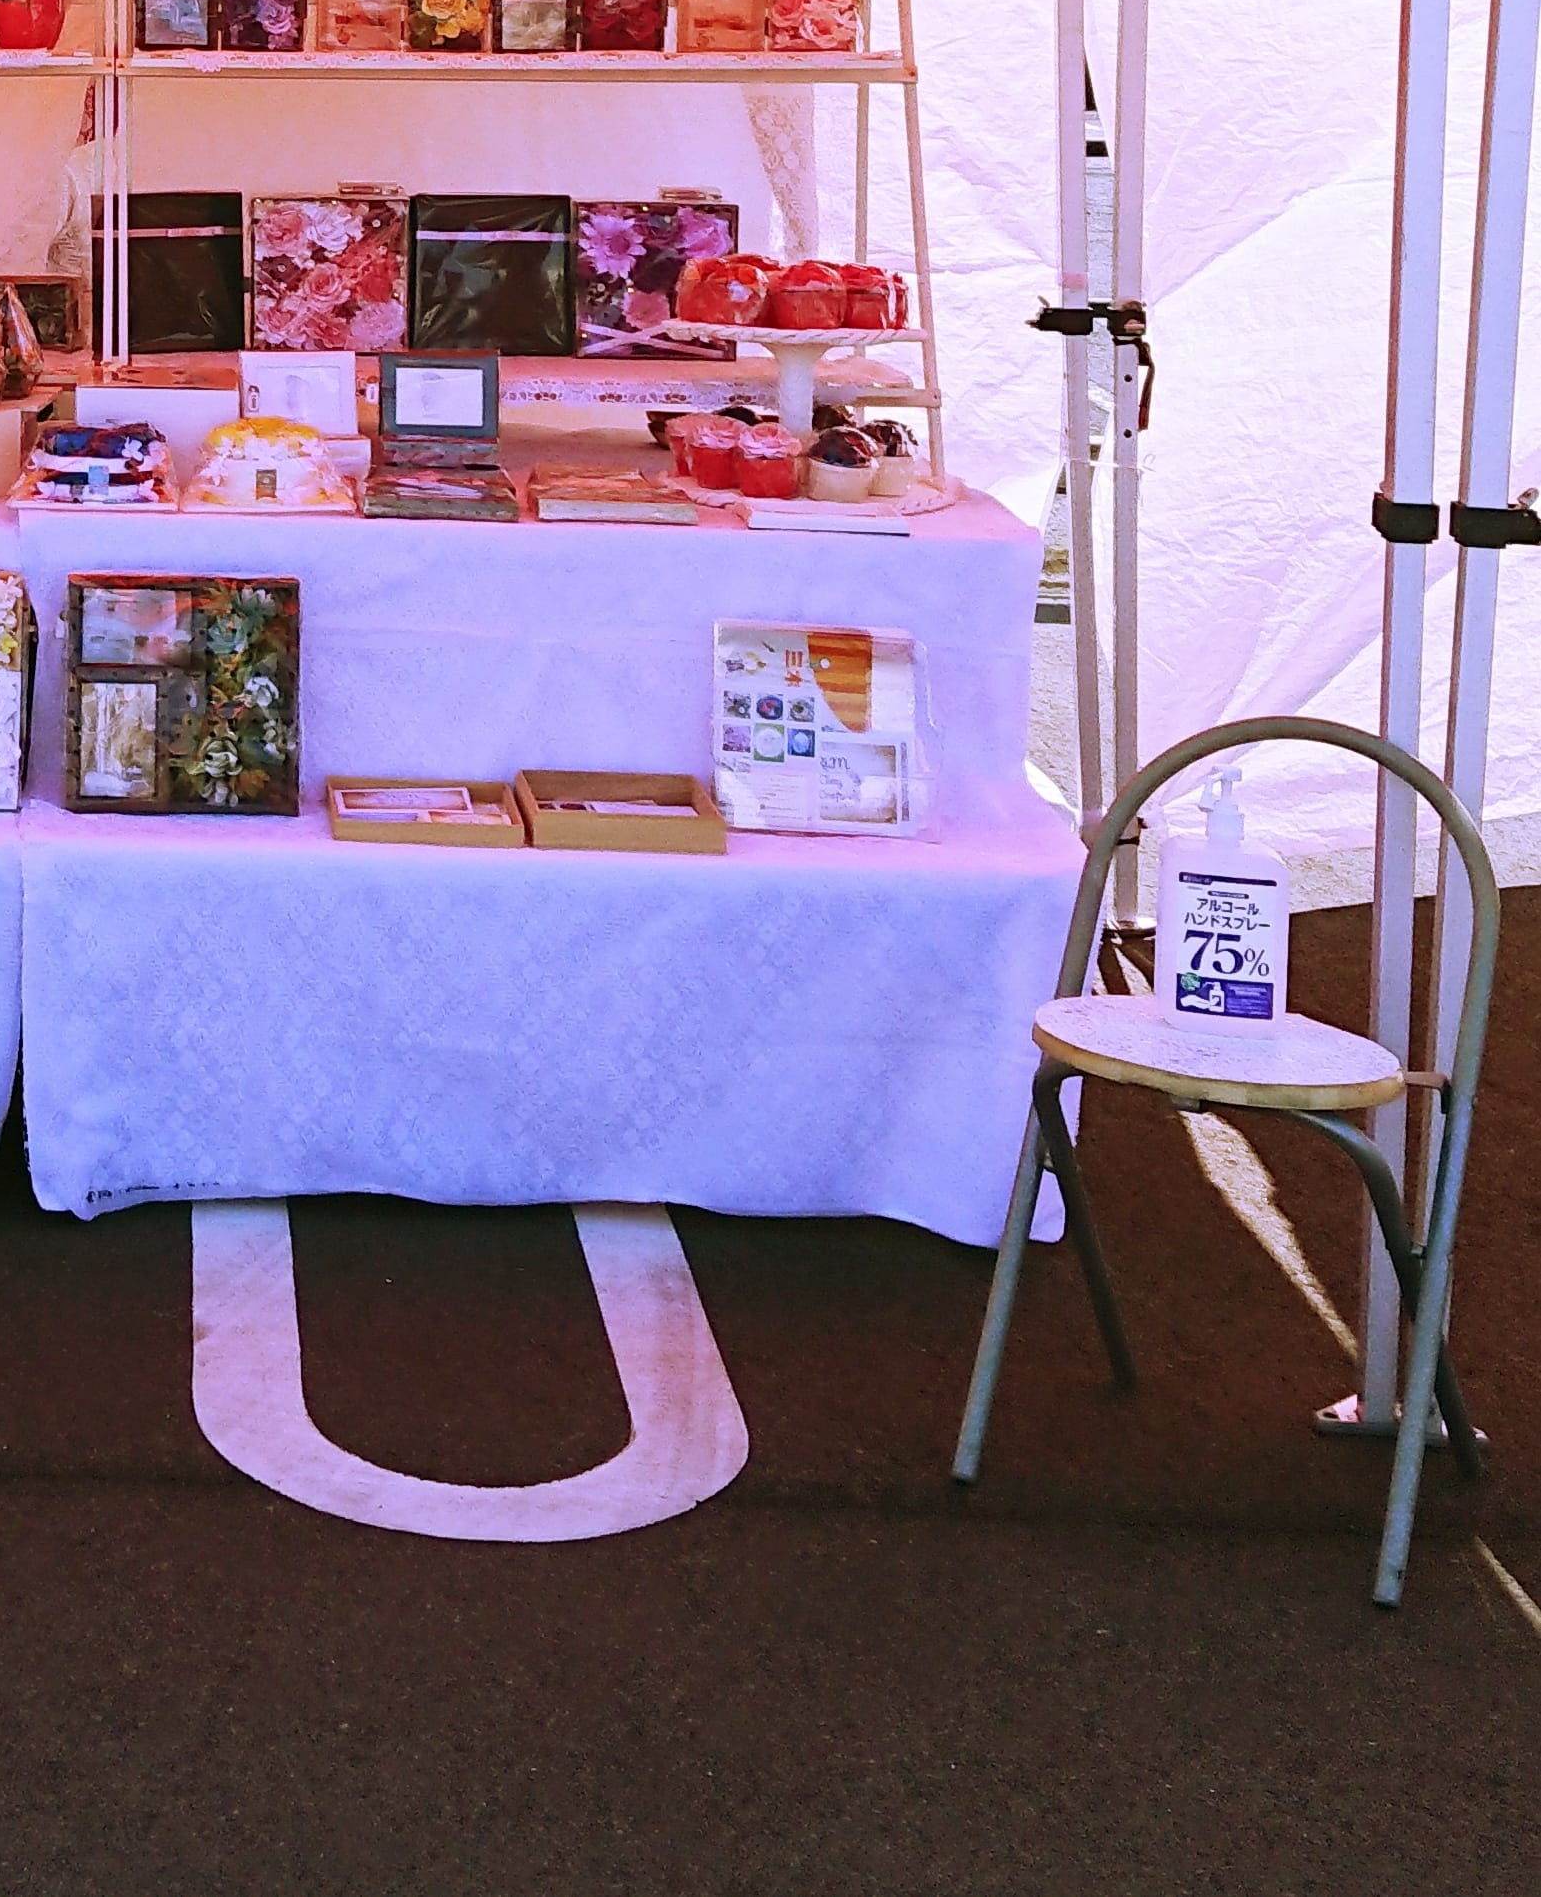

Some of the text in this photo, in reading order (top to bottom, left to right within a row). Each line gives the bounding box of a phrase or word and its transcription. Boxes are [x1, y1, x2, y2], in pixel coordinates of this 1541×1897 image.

[1196, 897, 1260, 916] アルコール
[1184, 911, 1271, 931] ハンドスプレー
[1182, 929, 1271, 977] 75%
